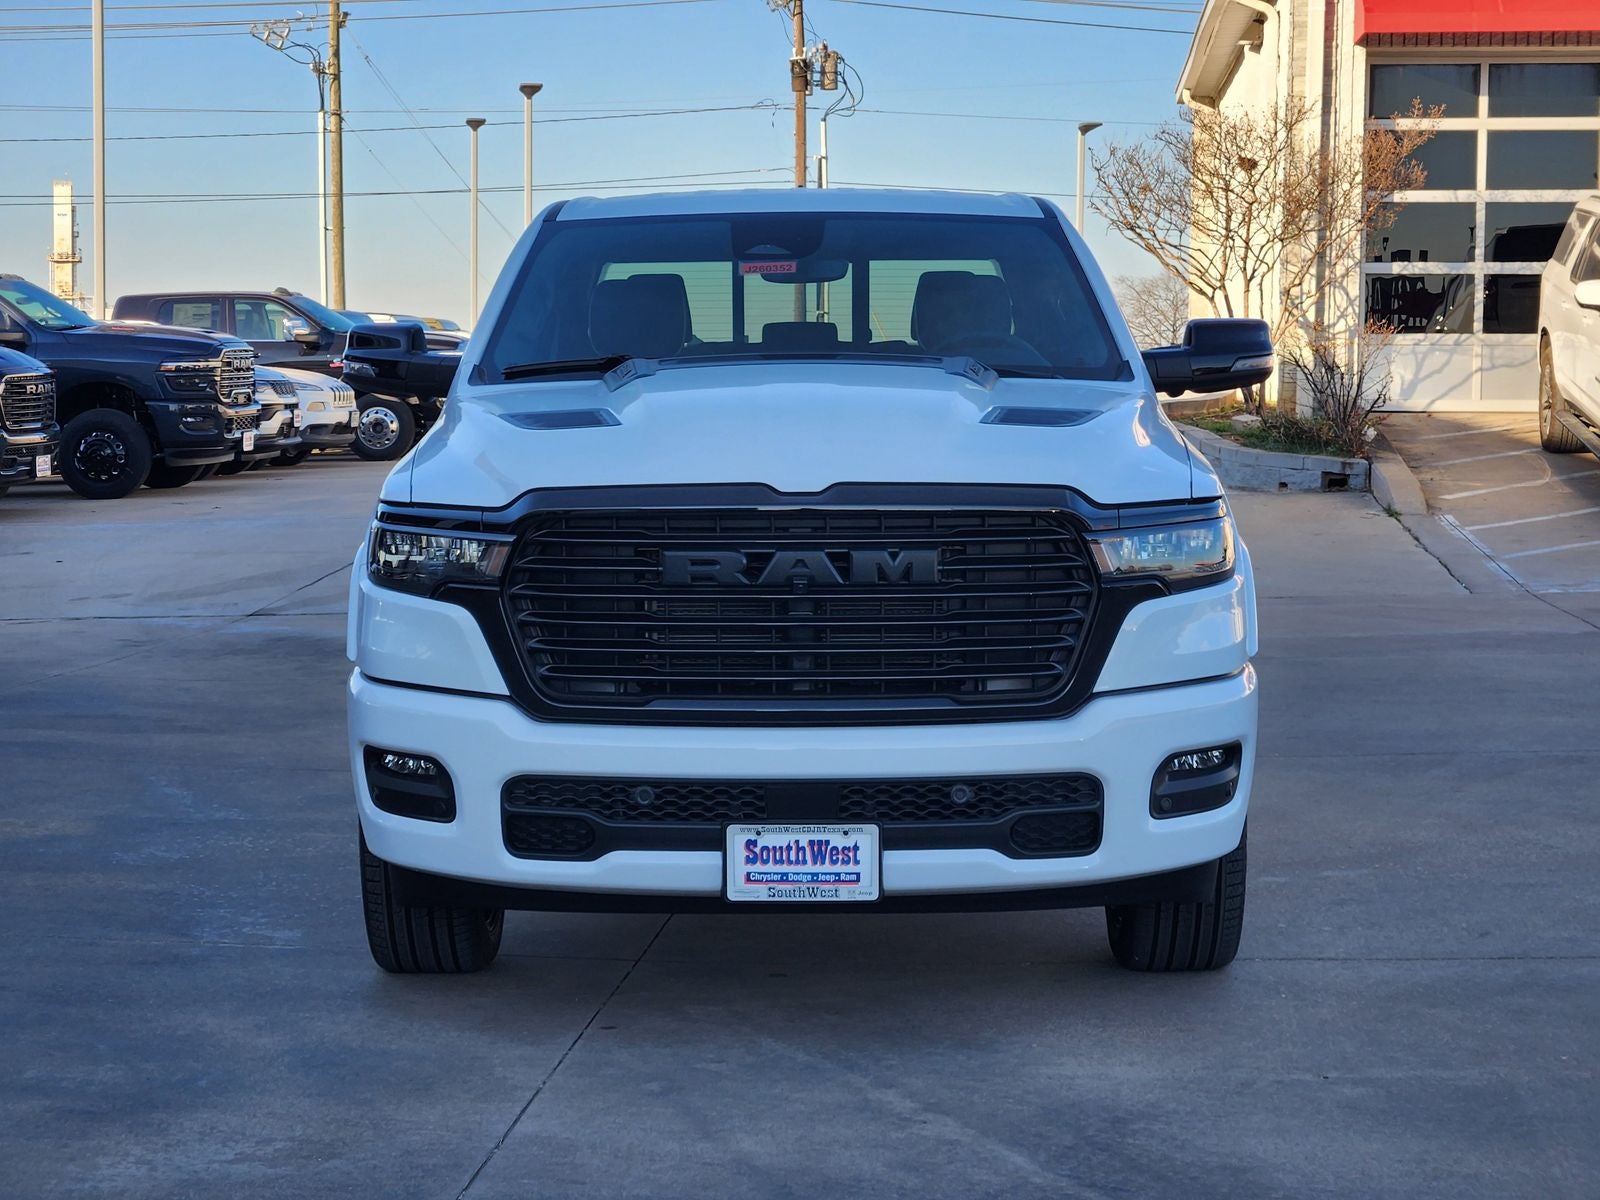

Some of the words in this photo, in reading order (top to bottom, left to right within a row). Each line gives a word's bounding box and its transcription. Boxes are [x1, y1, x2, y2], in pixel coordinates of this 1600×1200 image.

[662, 551, 940, 584] RAM
[750, 872, 782, 882] Chrysler
[788, 872, 812, 882] Dodge
[818, 873, 835, 882] Jeep
[840, 873, 857, 881] Ram
